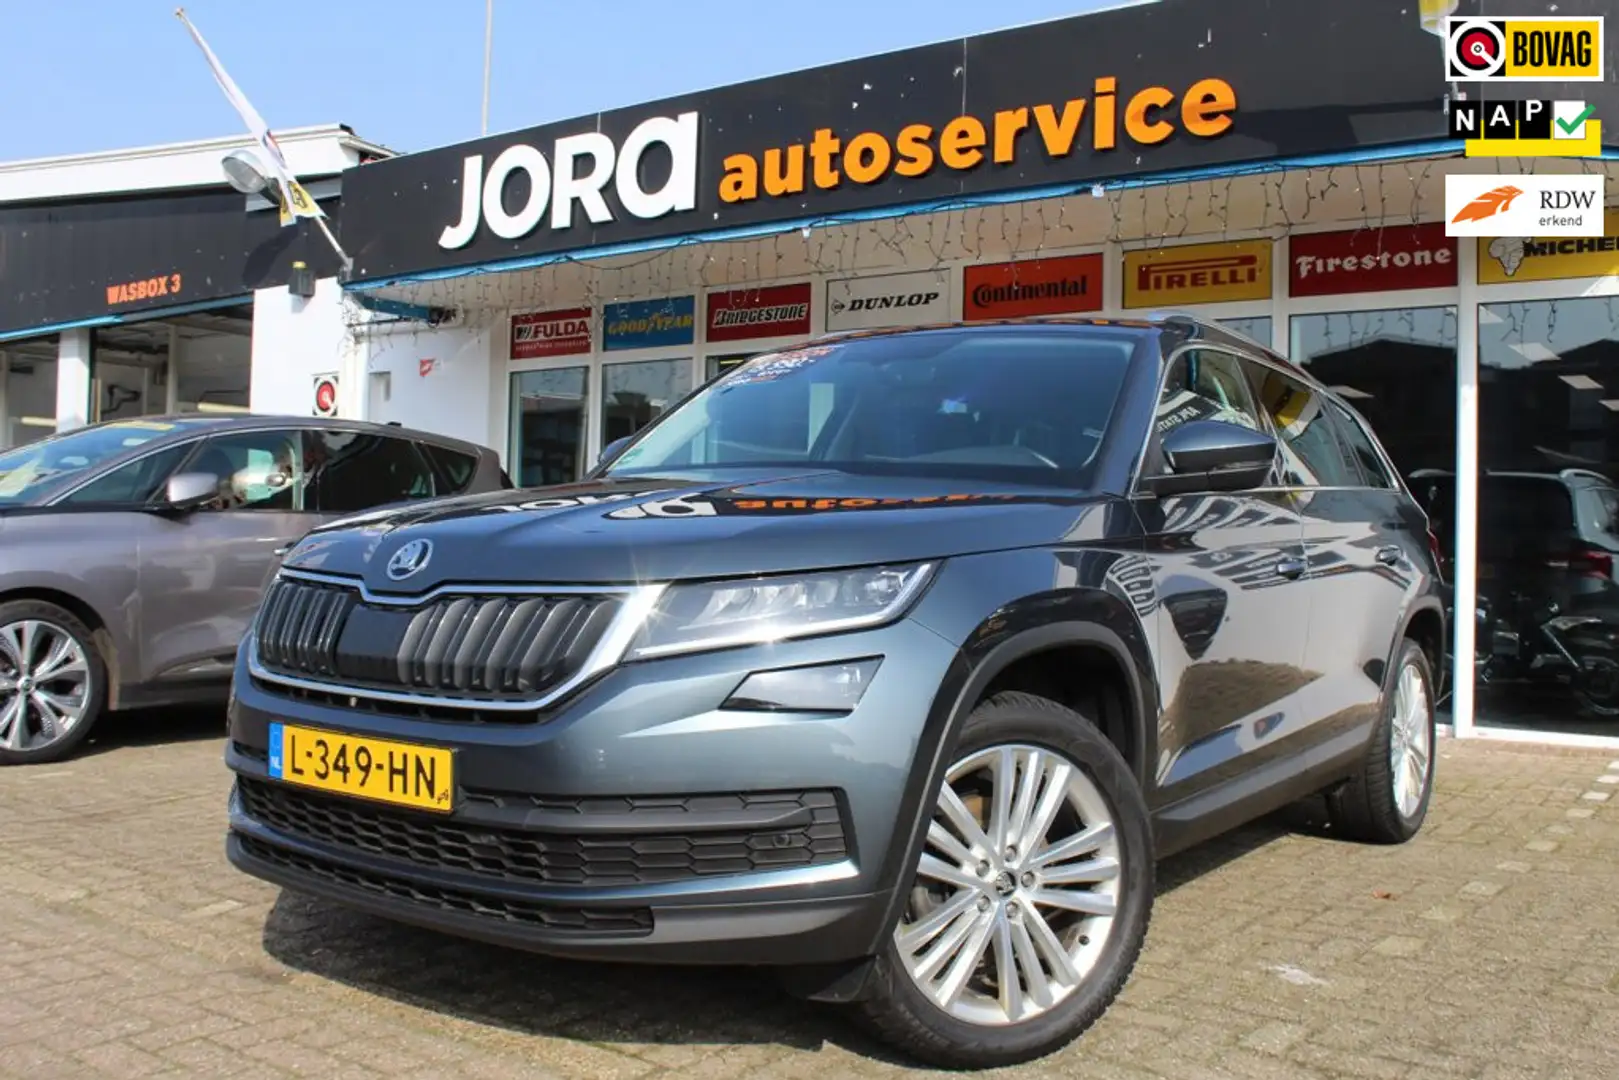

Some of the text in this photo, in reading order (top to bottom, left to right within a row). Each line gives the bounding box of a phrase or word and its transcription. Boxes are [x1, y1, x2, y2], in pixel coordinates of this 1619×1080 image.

[719, 77, 1236, 202] autoservice
[1523, 236, 1619, 257] MICHE
[1137, 255, 1257, 291] PIRELLI
[1296, 247, 1452, 278] Firestone
[106, 273, 181, 305] WASBOX 3
[849, 292, 939, 312] DUNLOP
[972, 275, 1087, 308] Continental
[533, 320, 589, 340] FULDA
[712, 303, 808, 328] BRIDGESTONE
[291, 734, 436, 799] L-349-HN
